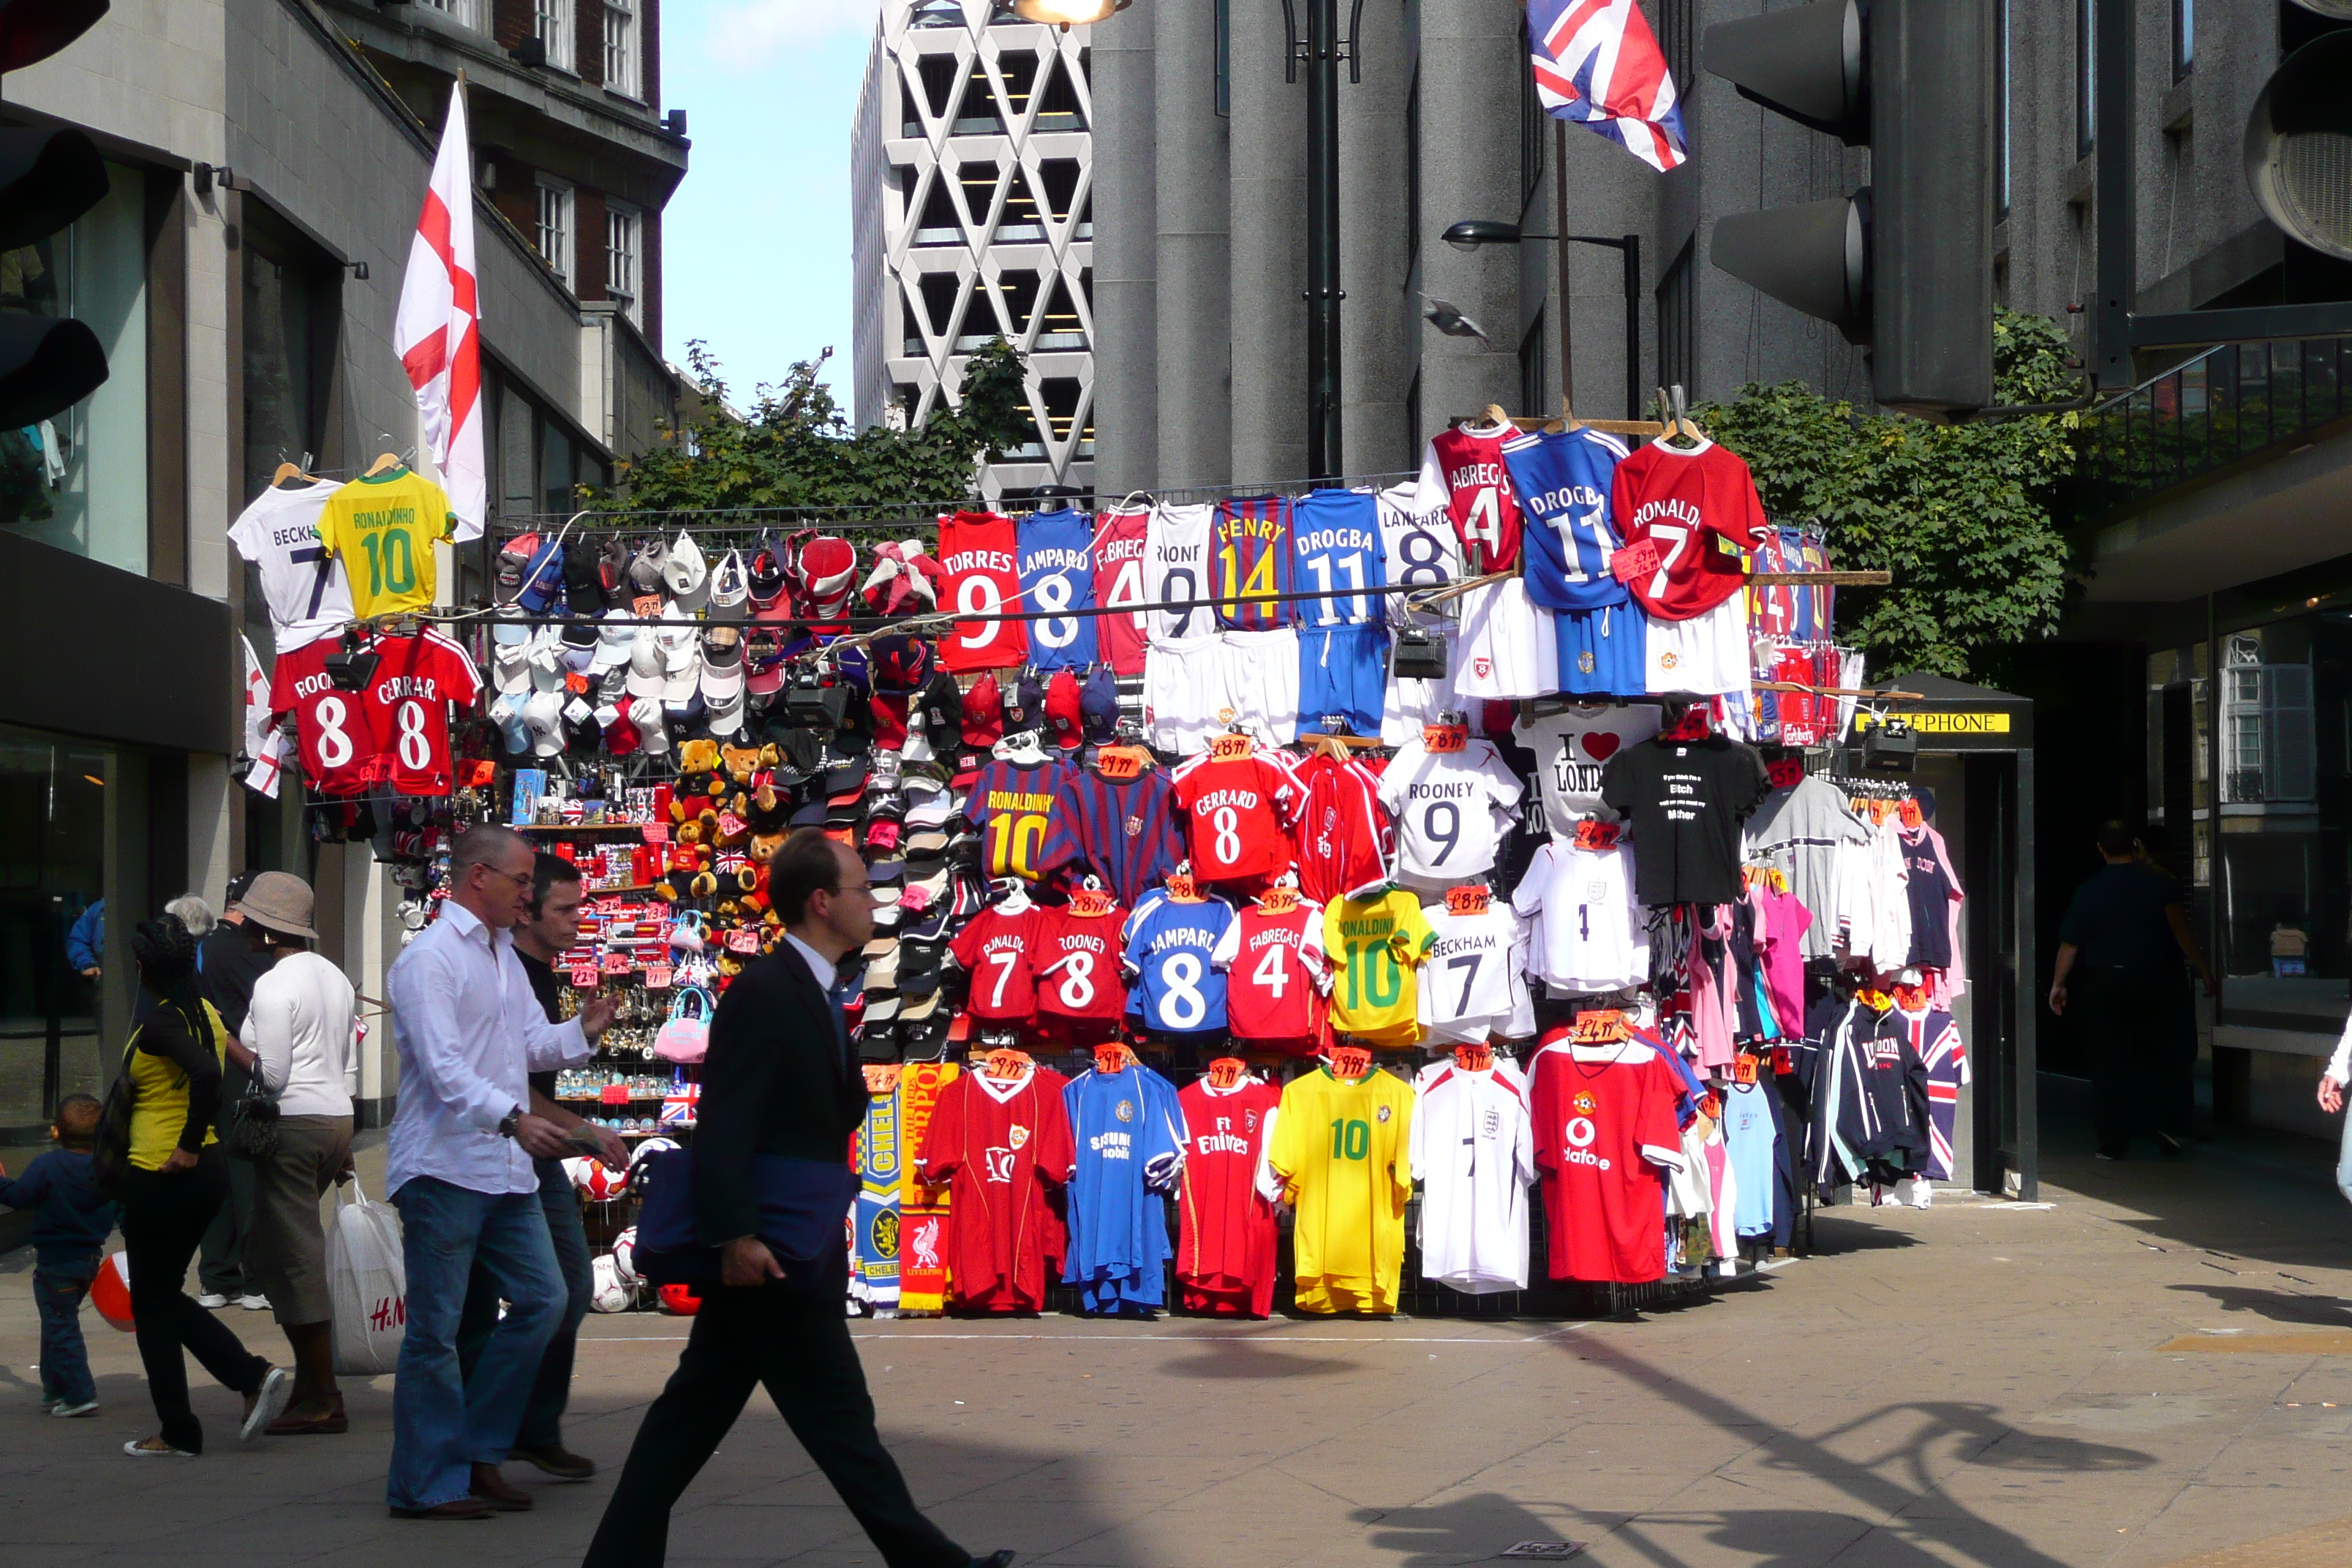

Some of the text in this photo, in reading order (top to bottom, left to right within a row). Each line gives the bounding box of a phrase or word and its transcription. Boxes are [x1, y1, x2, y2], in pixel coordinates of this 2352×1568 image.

[1450, 464, 1511, 496] ABREGS
[1217, 518, 1286, 543] HENRY
[1297, 528, 1373, 556] DROGBA
[1464, 486, 1502, 558] 4
[1546, 508, 1613, 581] 11
[290, 546, 335, 620] 7
[361, 528, 416, 597] 10
[943, 550, 1013, 576] TORRES
[1017, 549, 1088, 580] LAMPARD
[1218, 543, 1278, 617] 14
[1307, 551, 1369, 626] 11
[1399, 530, 1449, 602] 8
[1648, 524, 1688, 598] 7
[957, 575, 1002, 649] 9
[1033, 574, 1079, 648] 8
[1107, 560, 1148, 629] 4
[1161, 568, 1196, 638] 9
[315, 696, 353, 768] 8
[398, 701, 431, 770] 8
[1558, 734, 1577, 761] I
[1889, 714, 1996, 731] EPHONE
[1196, 789, 1257, 815] GERRARD
[1409, 781, 1474, 799] ROONEY
[1667, 809, 1696, 820] Mther
[989, 813, 1048, 881] 10
[1213, 807, 1240, 864] 8
[1424, 801, 1460, 867] 9
[1249, 928, 1300, 952] FABREGAS
[1252, 943, 1289, 998] 4
[1433, 935, 1496, 959] BECKHAM
[990, 951, 1017, 1007] 7
[1060, 951, 1094, 1008] 8
[1159, 952, 1206, 1029] 8
[1346, 938, 1402, 1010] 10
[1447, 954, 1482, 1017] 7
[1331, 1054, 1365, 1075] £9.99
[906, 1077, 916, 1142] THE REDS
[914, 1063, 939, 1151] ERPO
[1330, 1117, 1369, 1161] 10
[907, 1268, 943, 1276] LIVERPOOL
